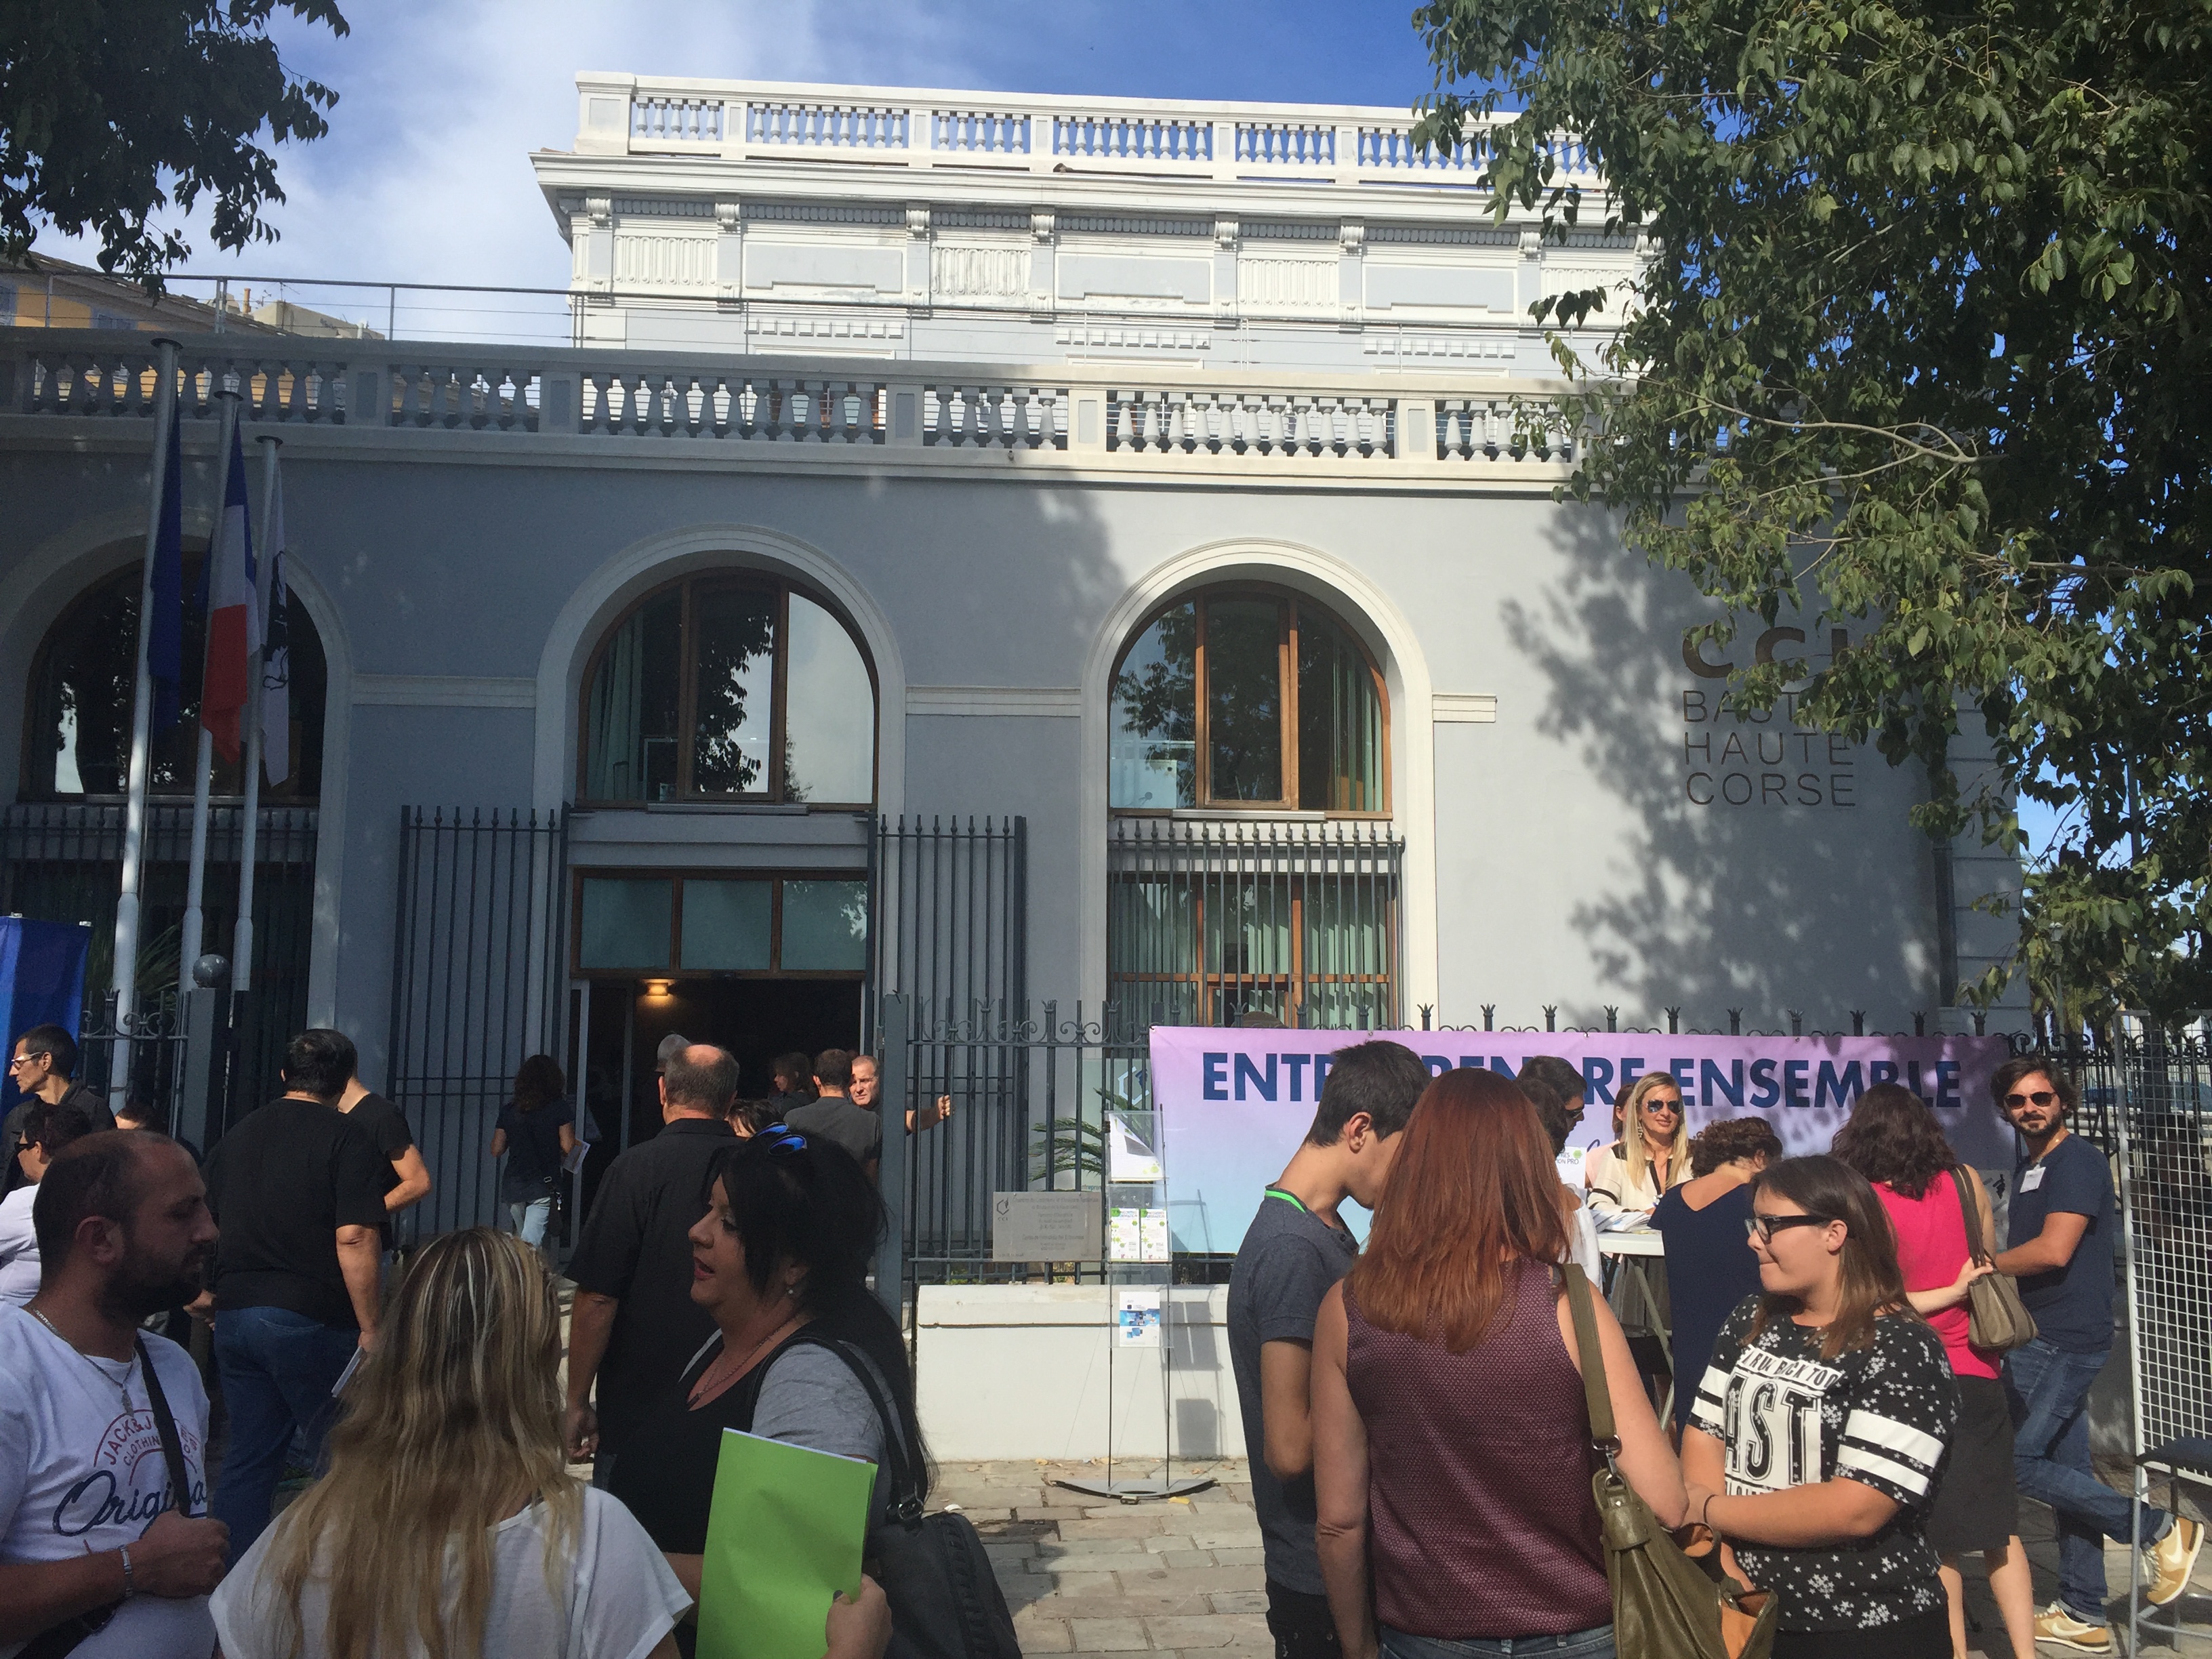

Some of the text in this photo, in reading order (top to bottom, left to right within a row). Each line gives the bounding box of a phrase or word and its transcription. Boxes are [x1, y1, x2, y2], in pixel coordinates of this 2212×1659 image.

[1684, 731, 1853, 765] HAUTE
[1686, 772, 1856, 806] CORSE
[123, 1435, 163, 1467] CLOTHIN
